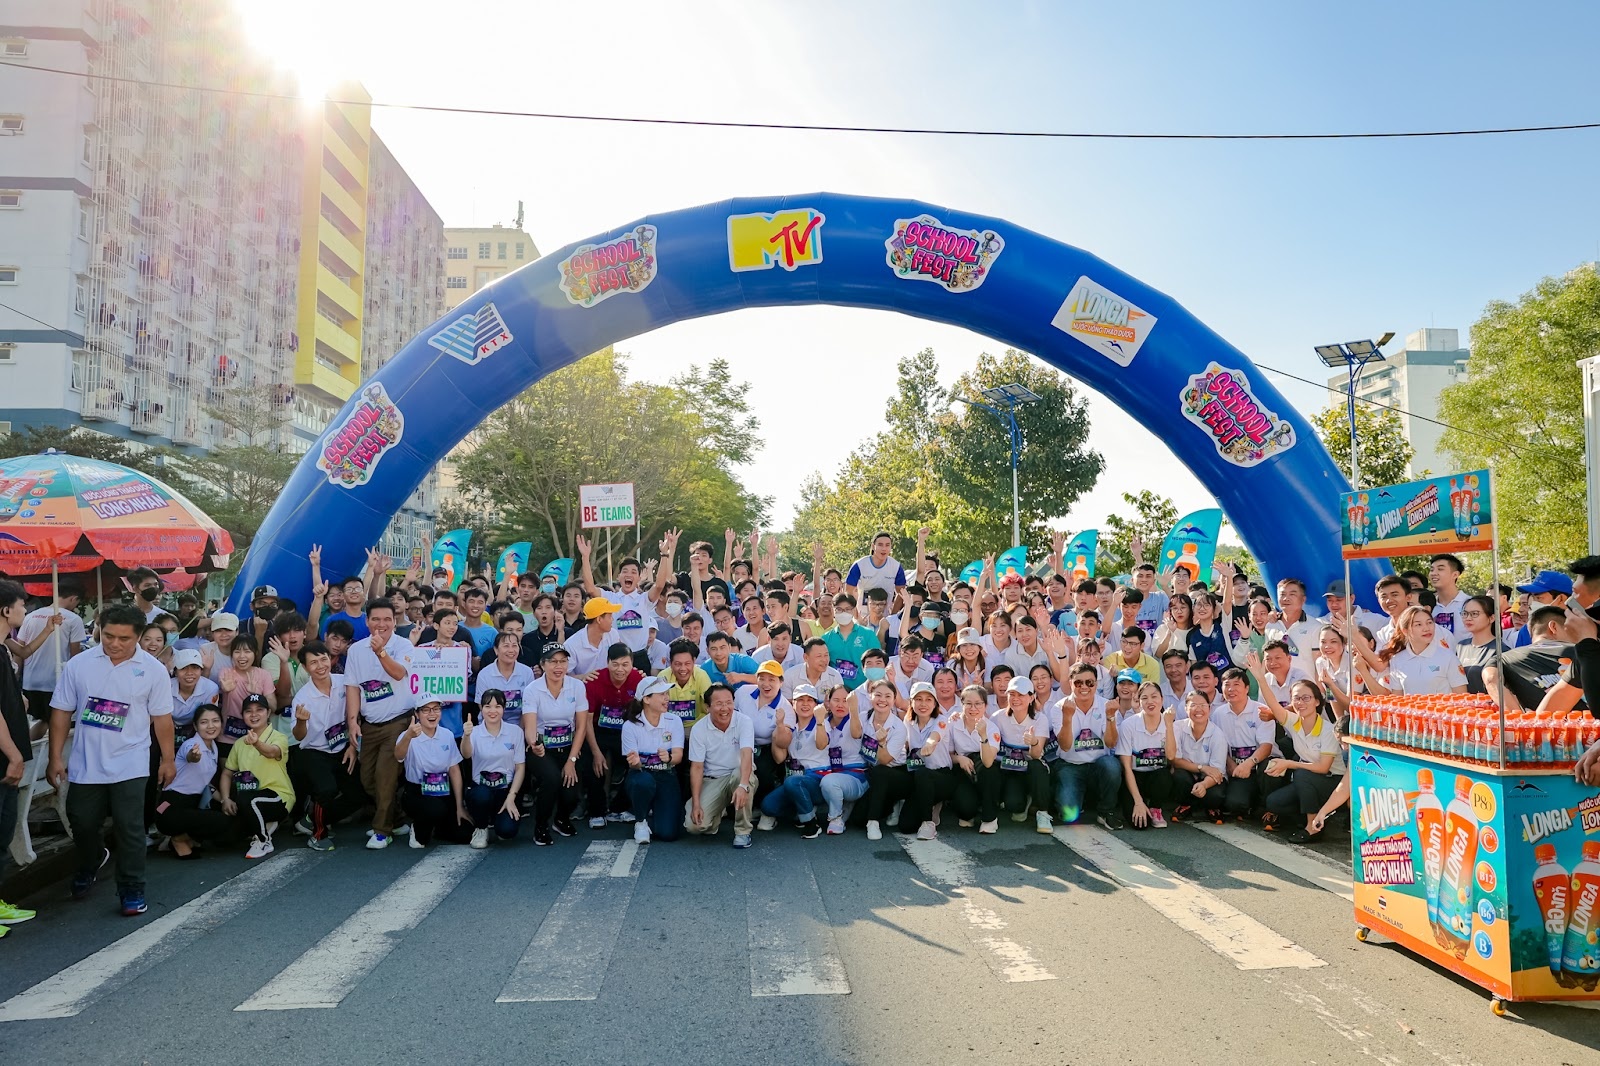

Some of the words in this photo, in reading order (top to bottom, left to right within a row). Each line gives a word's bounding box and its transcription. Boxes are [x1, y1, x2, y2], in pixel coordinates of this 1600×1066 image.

[731, 211, 821, 268] MTV
[904, 221, 980, 265] SCHOOL
[570, 239, 643, 279] SCHOOL
[911, 248, 959, 282] FEST
[588, 264, 631, 296] FEST
[1074, 287, 1130, 328] LONGA
[481, 332, 508, 354] KTX
[1197, 399, 1246, 447] FEST
[1208, 372, 1274, 448] SCHOOL
[324, 402, 384, 467] SCHOOL
[348, 427, 390, 470] FEST
[90, 500, 134, 519] LONG
[584, 506, 598, 522] BE
[600, 505, 632, 521] TEAMS
[1375, 508, 1403, 540] LONGA
[1407, 508, 1423, 528] LONG
[410, 673, 419, 695] C
[423, 676, 464, 695] TEAMS
[87, 712, 121, 726] F0075
[602, 716, 624, 725] F0009
[547, 735, 569, 744] F0135
[1076, 740, 1100, 748] F0037
[1358, 786, 1410, 836] LONGA
[1521, 808, 1572, 844] LONGA
[1362, 859, 1387, 884] LONG
[1443, 827, 1469, 890] LONGA
[1480, 871, 1494, 884] B12
[1363, 905, 1376, 916] MADE
[1382, 914, 1404, 930] THAILAND
[1569, 883, 1599, 936] LONGA
[1479, 937, 1488, 951] B
